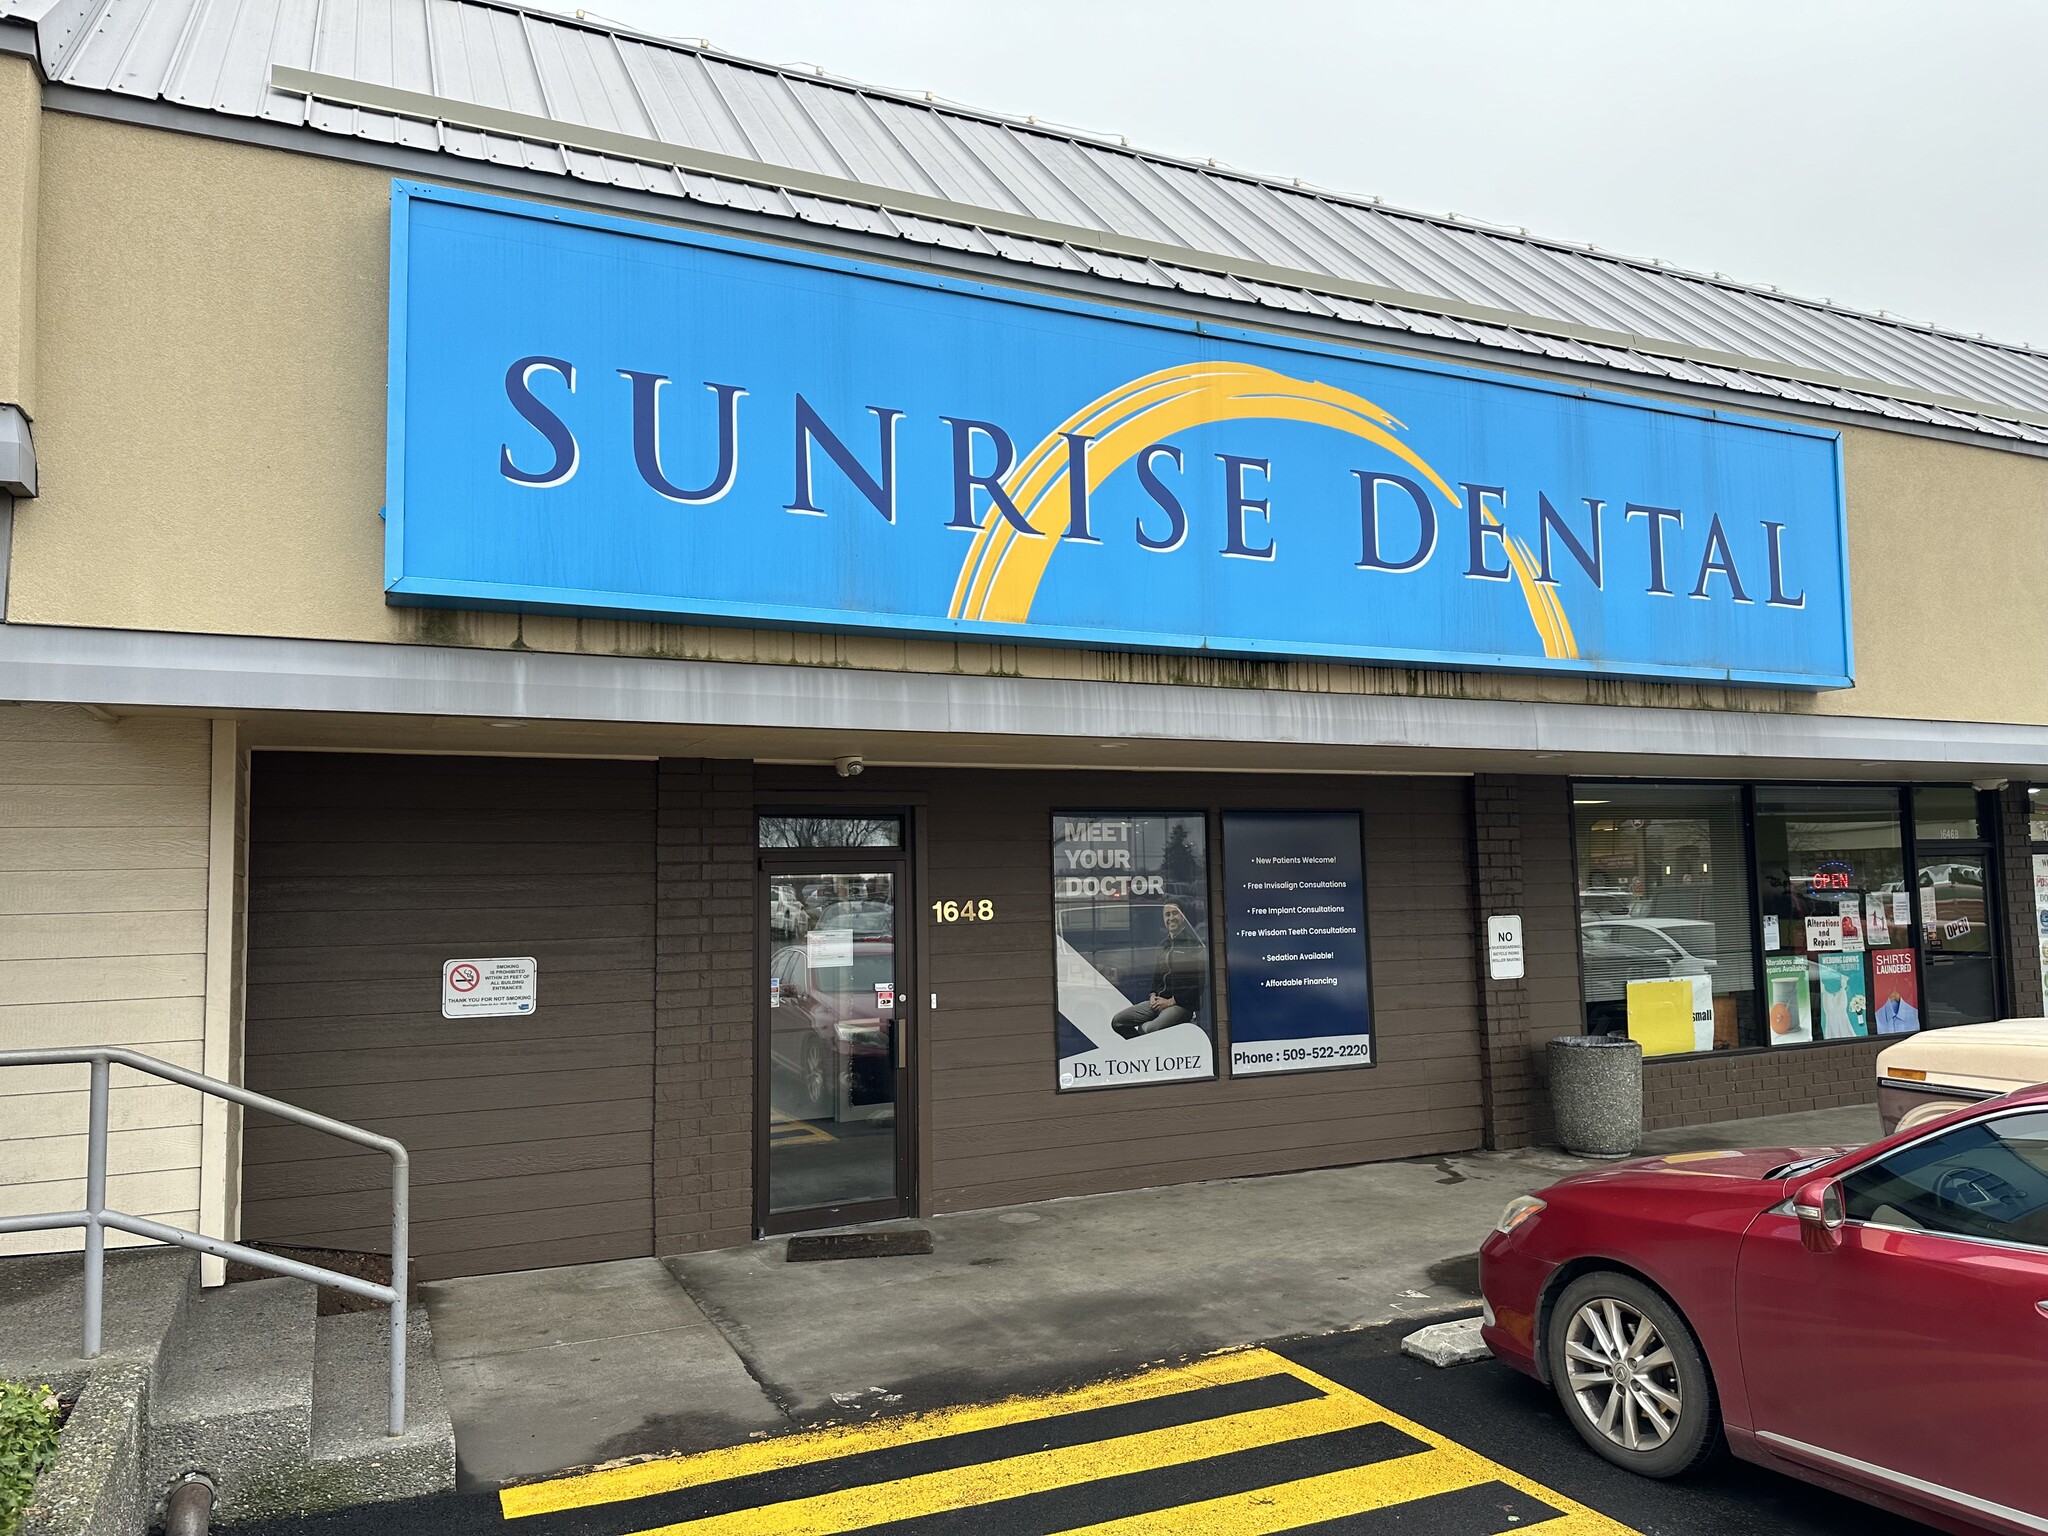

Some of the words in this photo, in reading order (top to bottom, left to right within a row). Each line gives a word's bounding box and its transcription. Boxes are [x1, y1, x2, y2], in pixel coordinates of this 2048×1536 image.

[500, 355, 1276, 562] SUNRISE
[1349, 468, 1806, 610] DENTAL
[1064, 822, 1132, 842] MEET
[1064, 848, 1131, 869] YOUR
[1256, 857, 1272, 865] New
[1273, 855, 1301, 864] Patients
[1302, 855, 1337, 864] Welcome!
[1065, 875, 1165, 896] DOCTOR
[1247, 882, 1263, 890] Free
[1264, 881, 1298, 891] Invisalign
[1299, 880, 1347, 889] Consultations
[1813, 873, 1849, 889] OPEN
[932, 899, 994, 923] 1648
[1251, 907, 1267, 915] Free
[1268, 906, 1296, 916] Implant
[1297, 905, 1345, 914] Consultations
[1807, 918, 1840, 928] Alterations
[1946, 919, 1969, 938] OPEN
[1241, 929, 1257, 937] Free
[1258, 928, 1287, 937] Wisdom
[1288, 927, 1308, 936] Teeth
[1308, 926, 1357, 935] Consultations
[1498, 931, 1513, 942] NO
[1818, 928, 1830, 937] and
[1813, 938, 1836, 948] Repairs
[1266, 953, 1298, 962] Sedation
[1299, 951, 1334, 961] Available!
[1876, 953, 1911, 965] SHIRTS
[1876, 963, 1912, 975] LAUNDERED
[1265, 978, 1302, 987] Affordable
[1303, 976, 1338, 986] Financing
[1692, 1009, 1712, 1022] small
[1234, 1051, 1273, 1065] Phone
[1282, 1043, 1368, 1062] 509-522-2220
